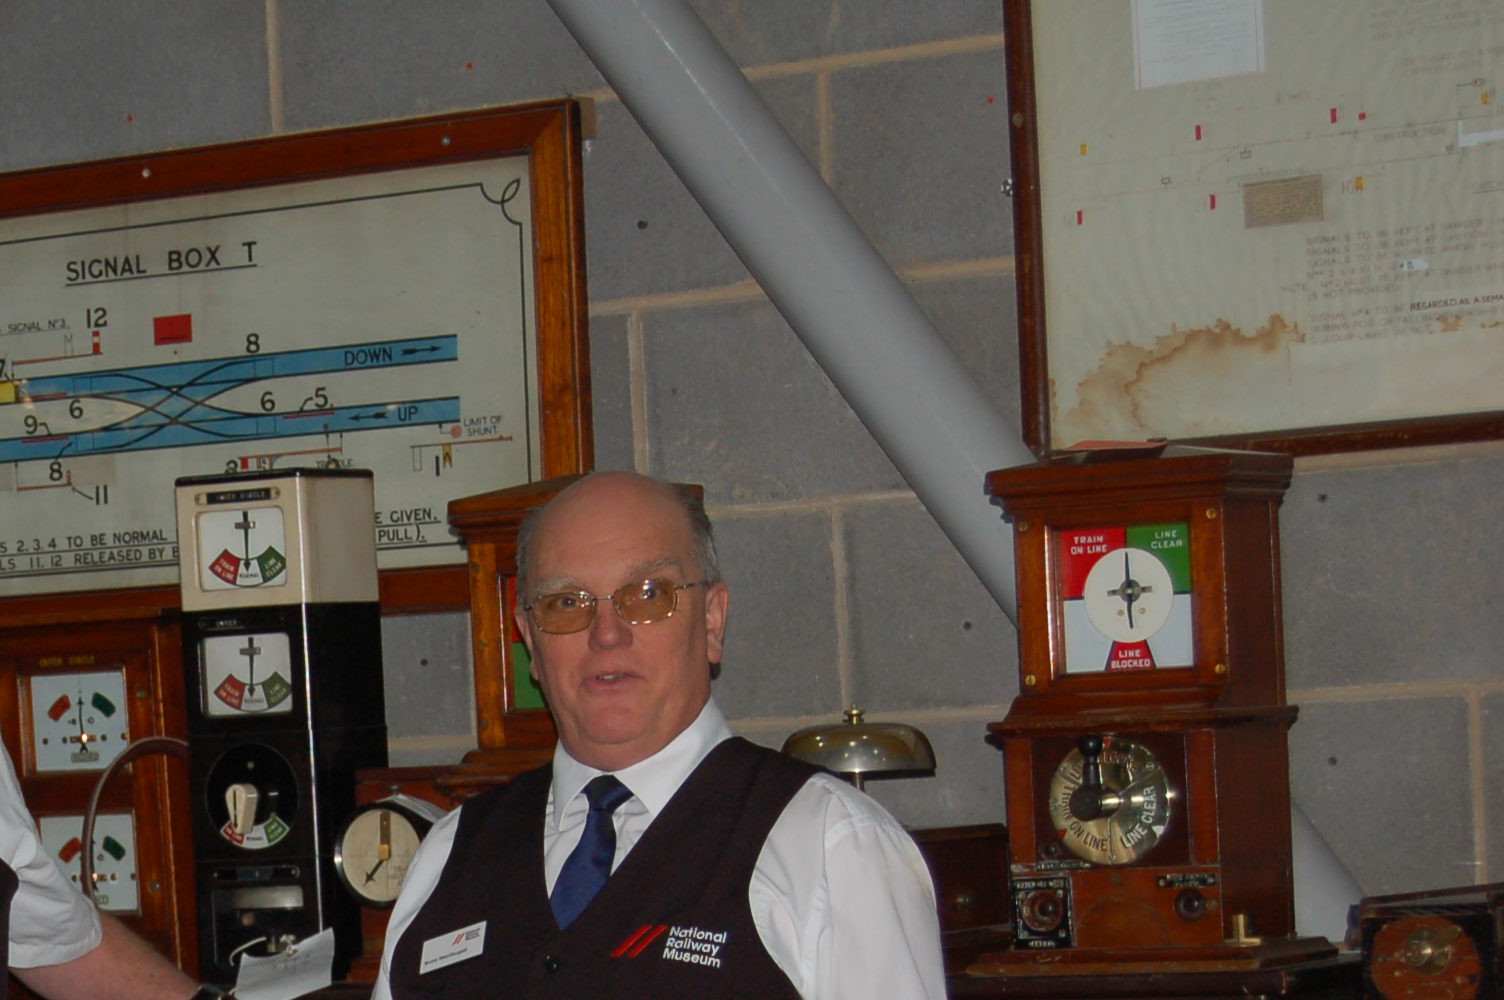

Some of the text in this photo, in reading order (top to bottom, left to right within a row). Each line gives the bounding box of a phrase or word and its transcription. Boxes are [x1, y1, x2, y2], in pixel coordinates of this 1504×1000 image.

[66, 241, 257, 282] SIGNAL BOX T
[8, 321, 42, 334] SIGNAL
[86, 307, 108, 329] 12
[245, 333, 260, 353] 8
[345, 346, 393, 365] DOWN
[69, 399, 84, 419] 6
[260, 391, 276, 412] 6
[397, 404, 418, 423] UP
[463, 414, 503, 428] LIMIT OF
[23, 415, 38, 435] 9
[466, 425, 498, 438] SHUNT
[49, 461, 63, 481] 8
[95, 485, 109, 505] 11
[66, 536, 84, 548] TO
[91, 533, 107, 546] BE
[113, 528, 167, 545] NORMAL
[389, 507, 438, 524] GIVEN.
[1154, 530, 1178, 540] LINE
[1073, 534, 1104, 545] TRAIN
[1150, 539, 1183, 549] CLEAR
[74, 549, 143, 566] RELEASED
[148, 547, 166, 561] BY
[1070, 544, 1107, 556] ON LINE
[1111, 658, 1151, 669] BLOCKED
[1118, 649, 1141, 659] LINE
[1120, 785, 1157, 848] LINE CLEAR
[1069, 821, 1085, 838] ON
[1082, 832, 1109, 852] LINE
[668, 926, 727, 944] National
[666, 937, 720, 957] Railway
[662, 948, 721, 968] Museum
